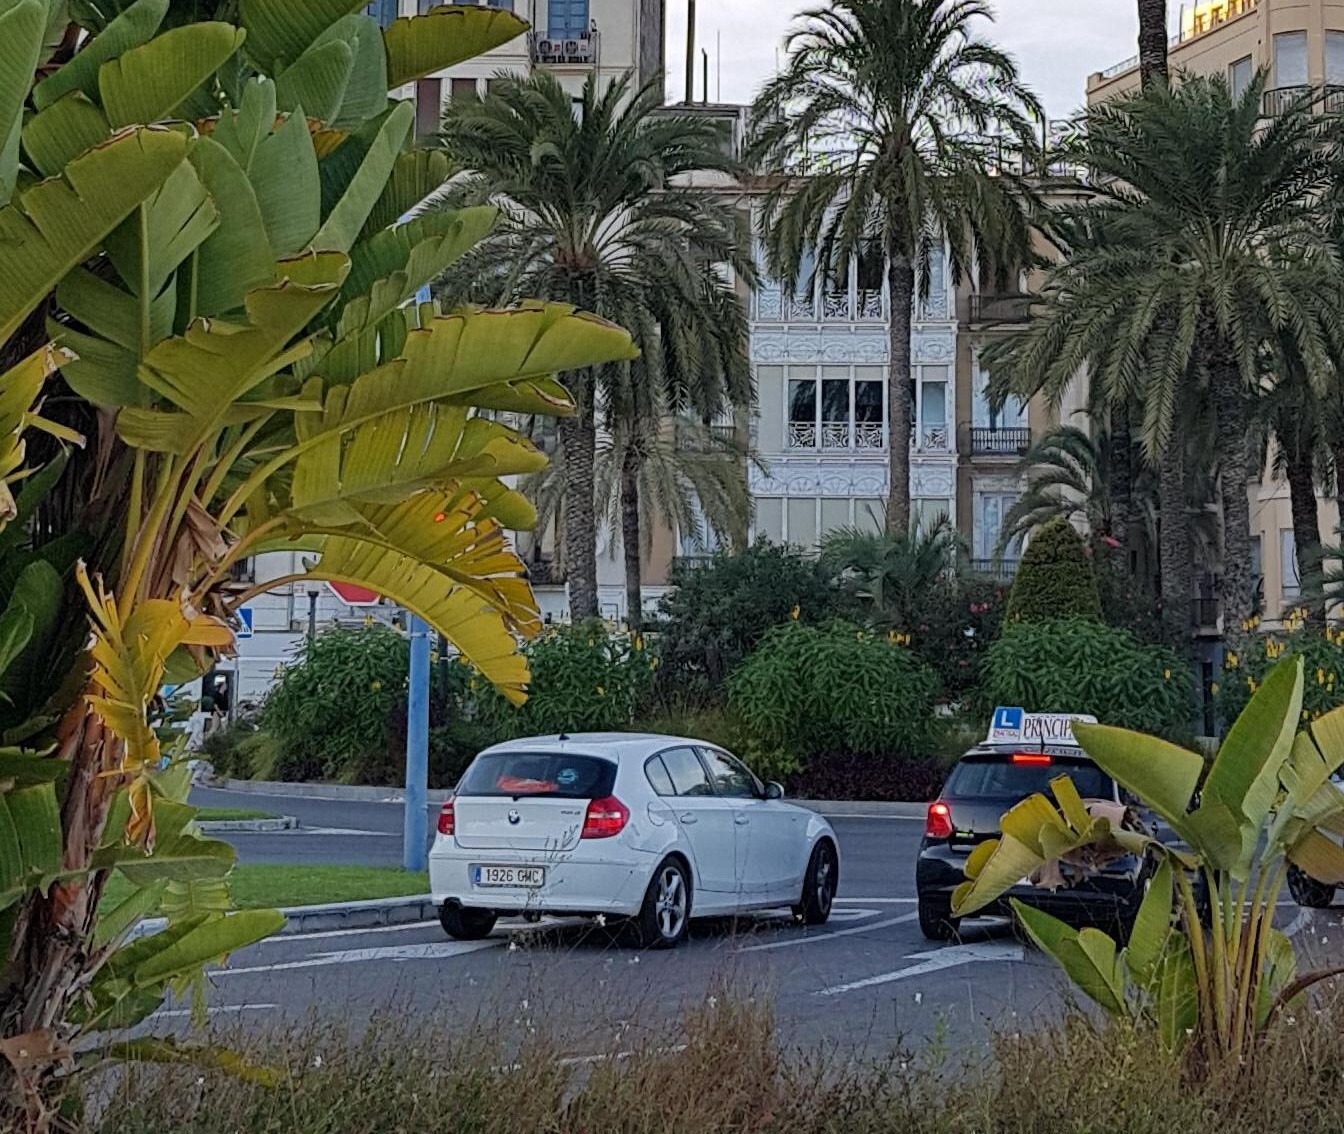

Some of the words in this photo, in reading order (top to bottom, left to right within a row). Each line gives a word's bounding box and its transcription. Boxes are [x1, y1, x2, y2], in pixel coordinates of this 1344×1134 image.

[1001, 710, 1014, 727] L
[1023, 718, 1075, 739] PRINCIP
[486, 868, 514, 883] 1926
[517, 869, 539, 884] GMC
